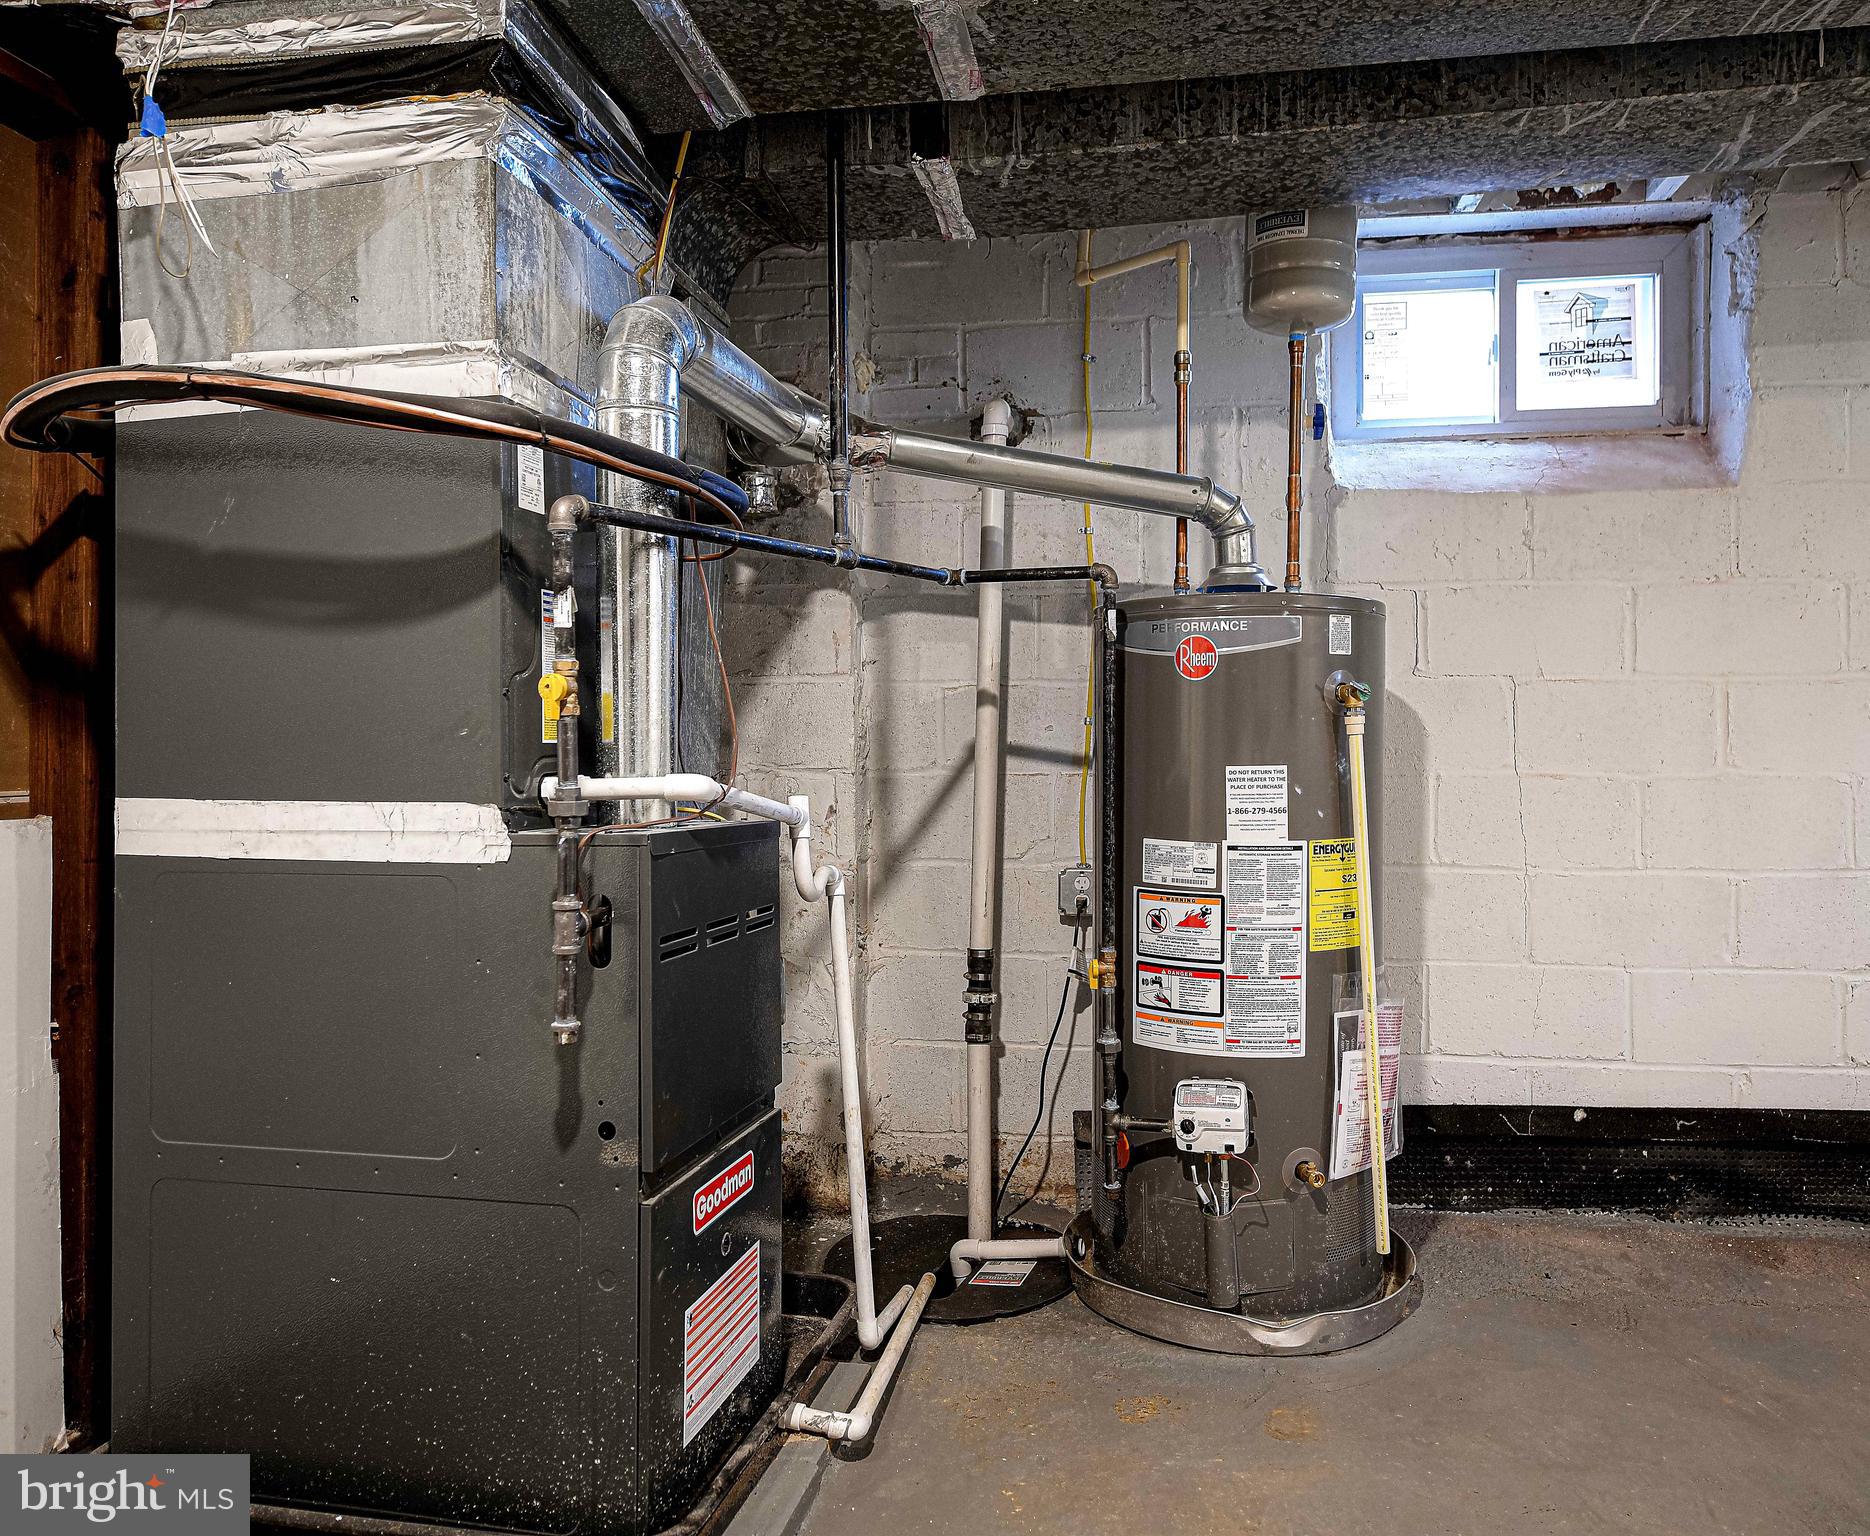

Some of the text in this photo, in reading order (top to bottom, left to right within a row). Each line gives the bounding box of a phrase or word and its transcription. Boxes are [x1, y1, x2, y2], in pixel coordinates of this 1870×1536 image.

[1151, 620, 1248, 633] PERFORMANCE
[1180, 637, 1215, 672] Rheem
[696, 1164, 751, 1220] Goodman
